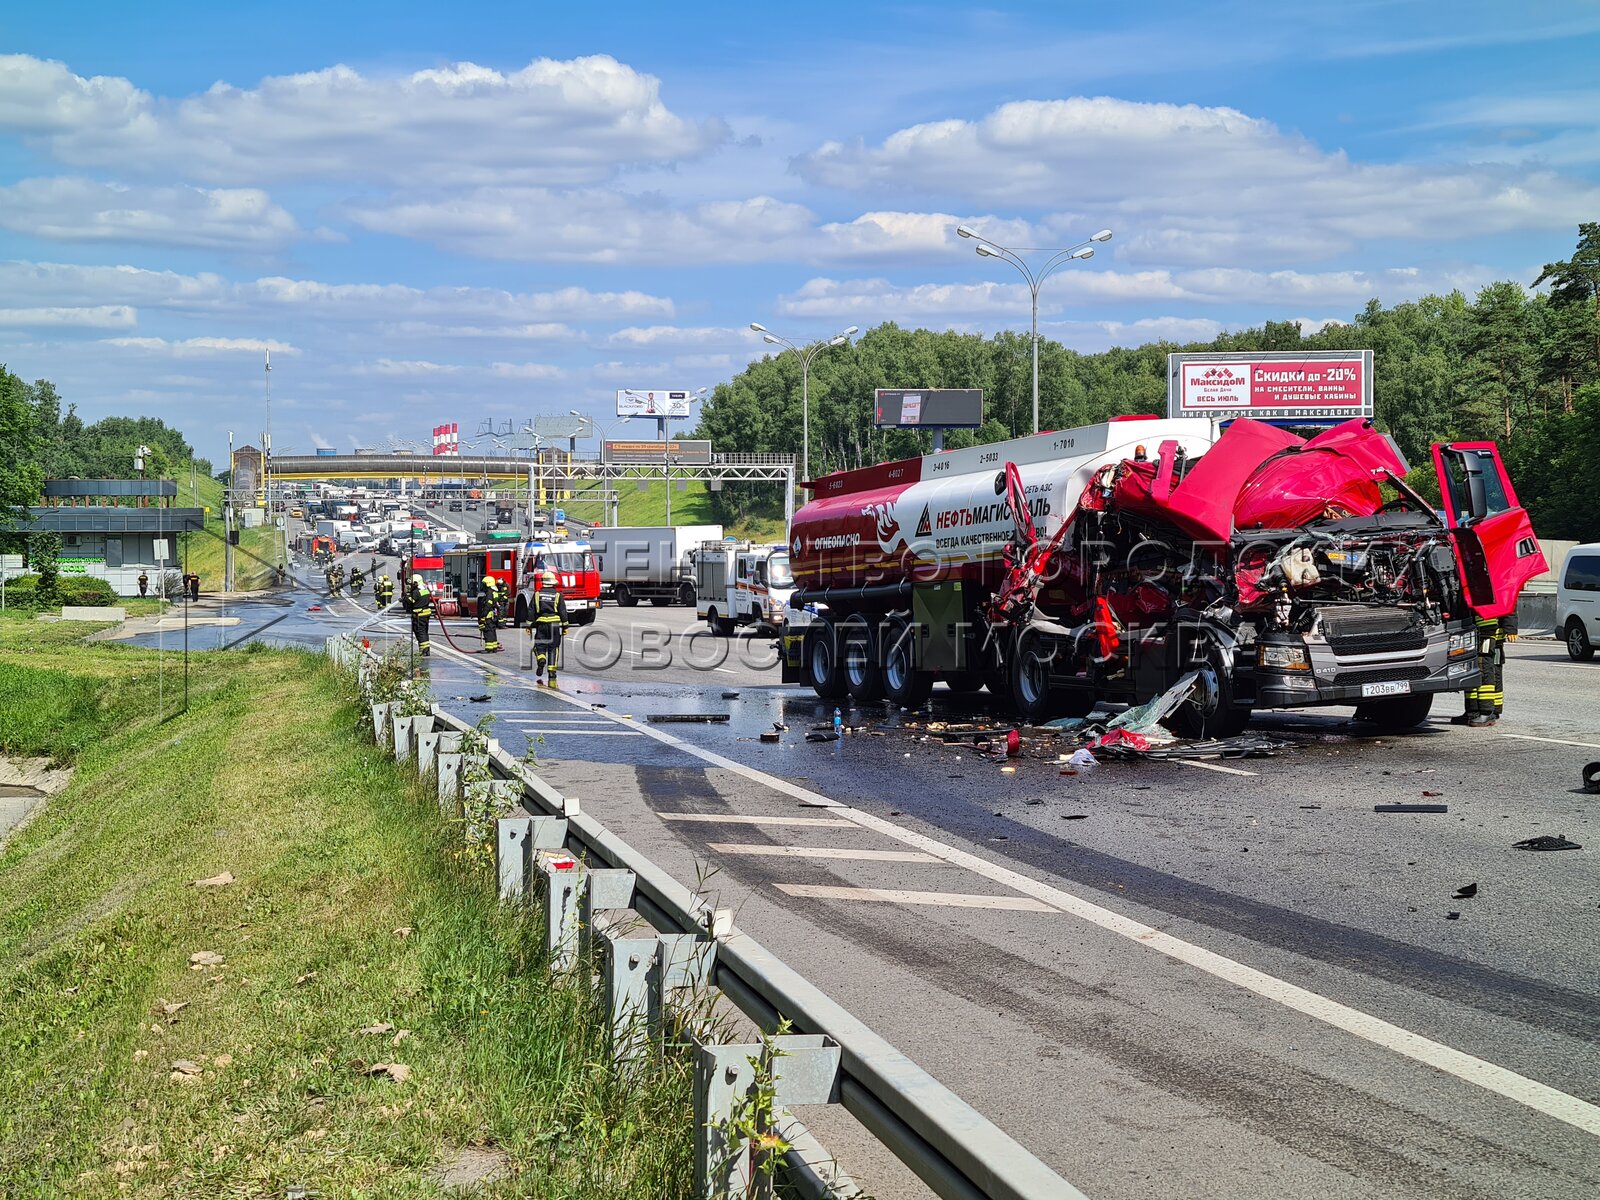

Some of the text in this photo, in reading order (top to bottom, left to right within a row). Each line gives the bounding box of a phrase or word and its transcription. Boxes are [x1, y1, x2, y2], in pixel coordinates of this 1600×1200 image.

[1322, 368, 1356, 381] -20%
[1024, 483, 1053, 494] СЕТЬ АЗС
[936, 498, 1050, 530] НЕФТЬМАГИСАЛЬ
[814, 533, 860, 550] ОГНЕОПАСНО
[936, 538, 960, 549] ВСЕГДА
[961, 532, 1010, 546] КАЧЕСТВЕННОЕ
[1366, 685, 1395, 695] Т203ВВ
